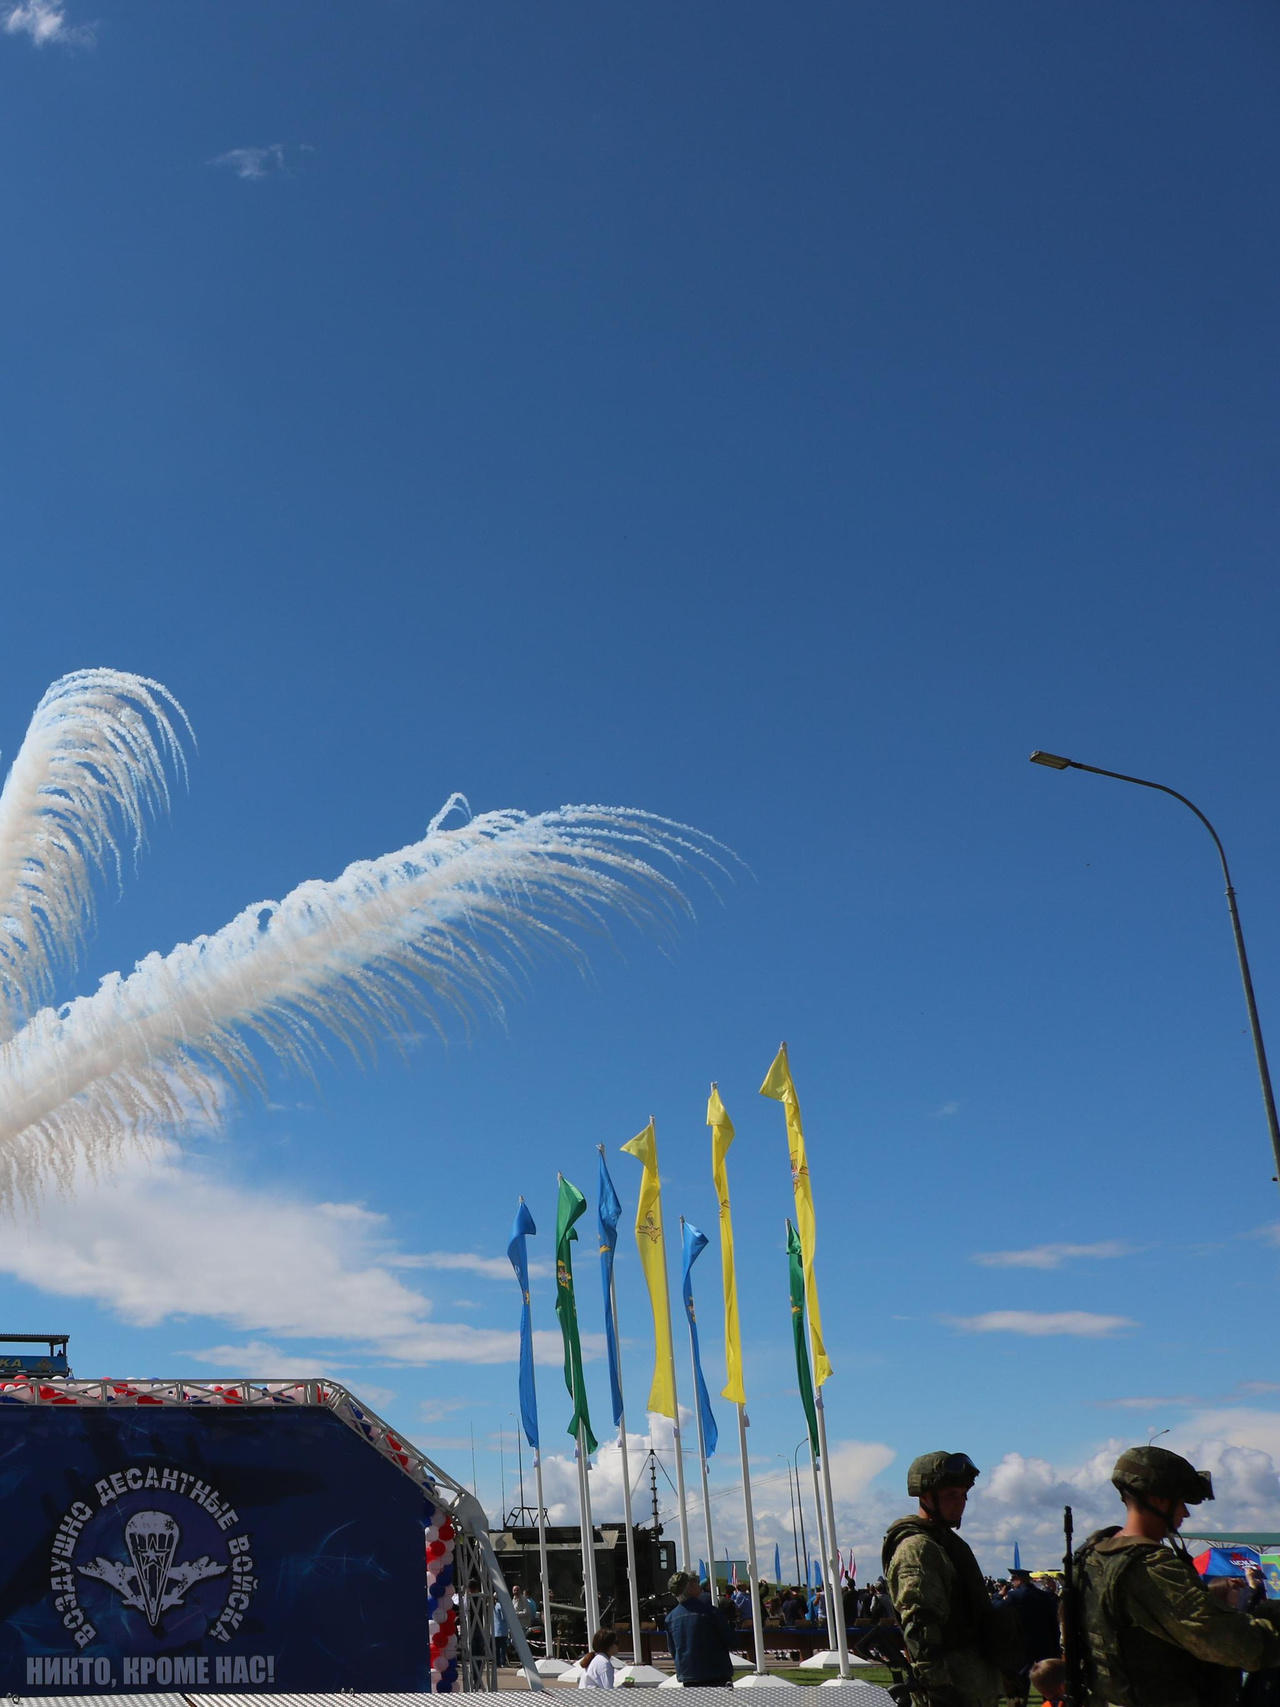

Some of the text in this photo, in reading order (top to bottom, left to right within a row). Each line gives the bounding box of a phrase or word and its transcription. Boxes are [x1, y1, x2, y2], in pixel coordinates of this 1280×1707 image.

[95, 1465, 239, 1531] ДЕСАНТНЫЕ
[208, 1534, 260, 1643] ВОЙСКА
[26, 1655, 275, 1687] НИКТО, КРОМЕ НАС!
